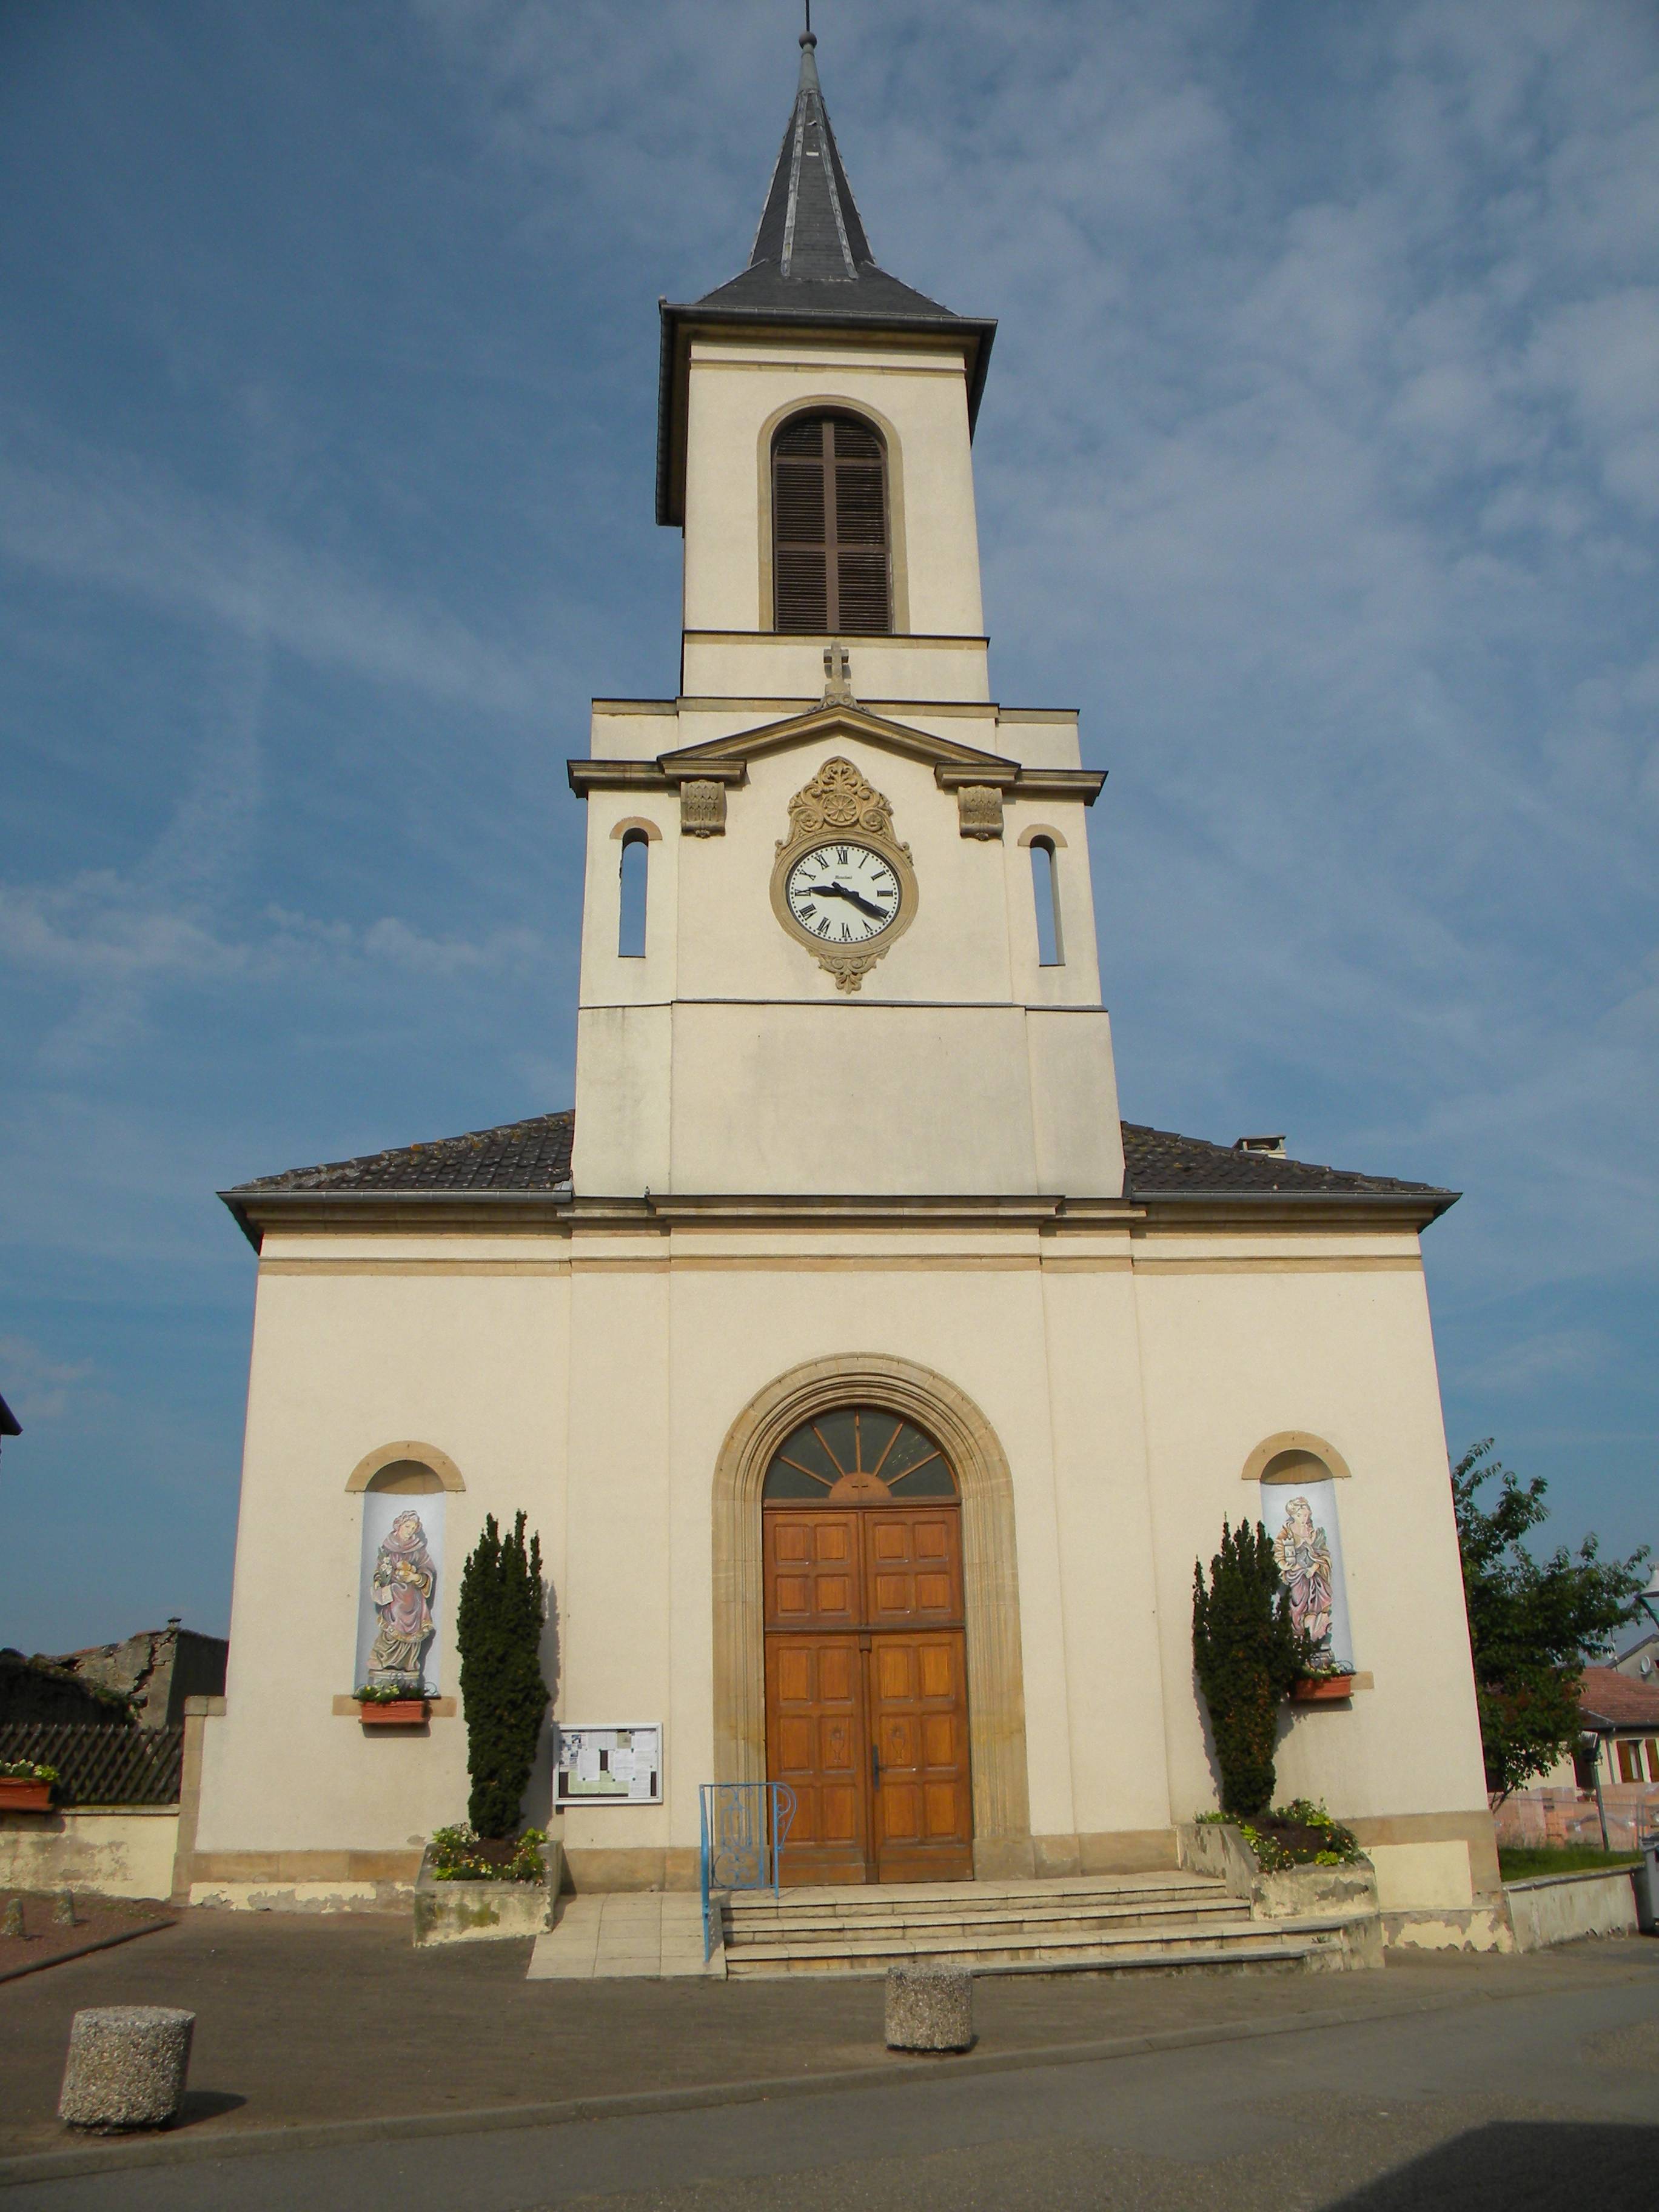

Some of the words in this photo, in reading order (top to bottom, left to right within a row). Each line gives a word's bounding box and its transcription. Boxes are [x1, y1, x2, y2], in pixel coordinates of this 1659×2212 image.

[814, 854, 830, 870] XI
[836, 850, 848, 864] XII
[858, 855, 868, 868] I
[799, 869, 816, 880] X
[871, 870, 886, 880] II
[795, 888, 811, 897] IX
[799, 903, 817, 920] VIII
[817, 916, 831, 934] VII
[841, 922, 851, 937] VI
[862, 919, 873, 933] V
